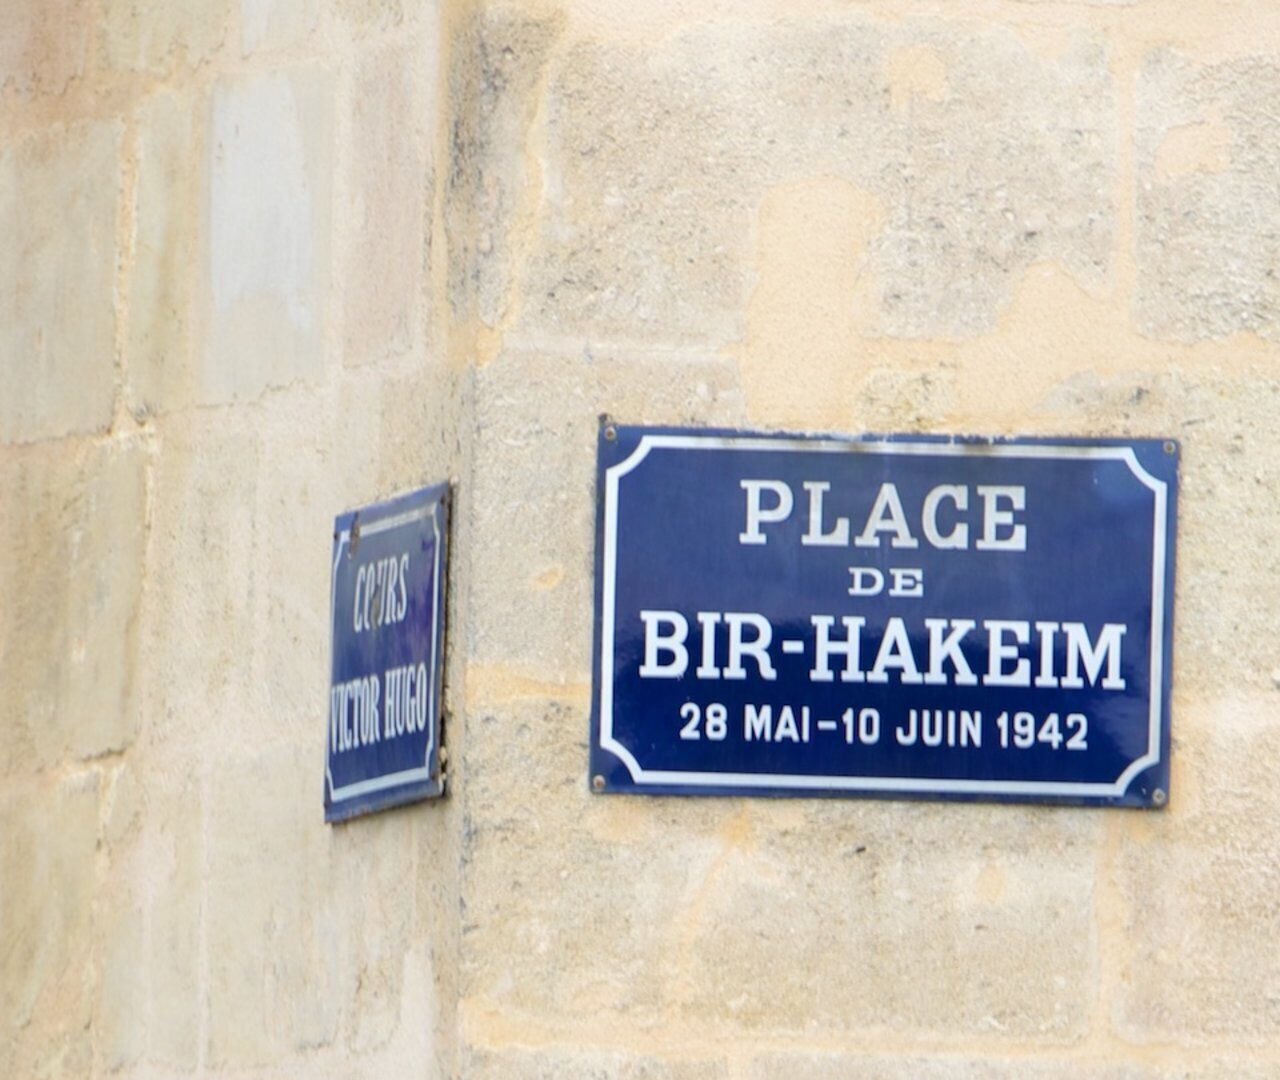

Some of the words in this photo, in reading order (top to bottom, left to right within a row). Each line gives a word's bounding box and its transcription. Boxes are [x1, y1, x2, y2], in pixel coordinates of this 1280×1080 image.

[739, 479, 1027, 551] PLACE
[847, 566, 924, 597] DE
[638, 610, 1128, 690] BIR-HAKEIM
[331, 674, 381, 753] VICTOR
[385, 662, 428, 739] HUGO
[679, 702, 728, 740] 28
[895, 709, 982, 748] JUIN
[996, 711, 1088, 750] 1942
